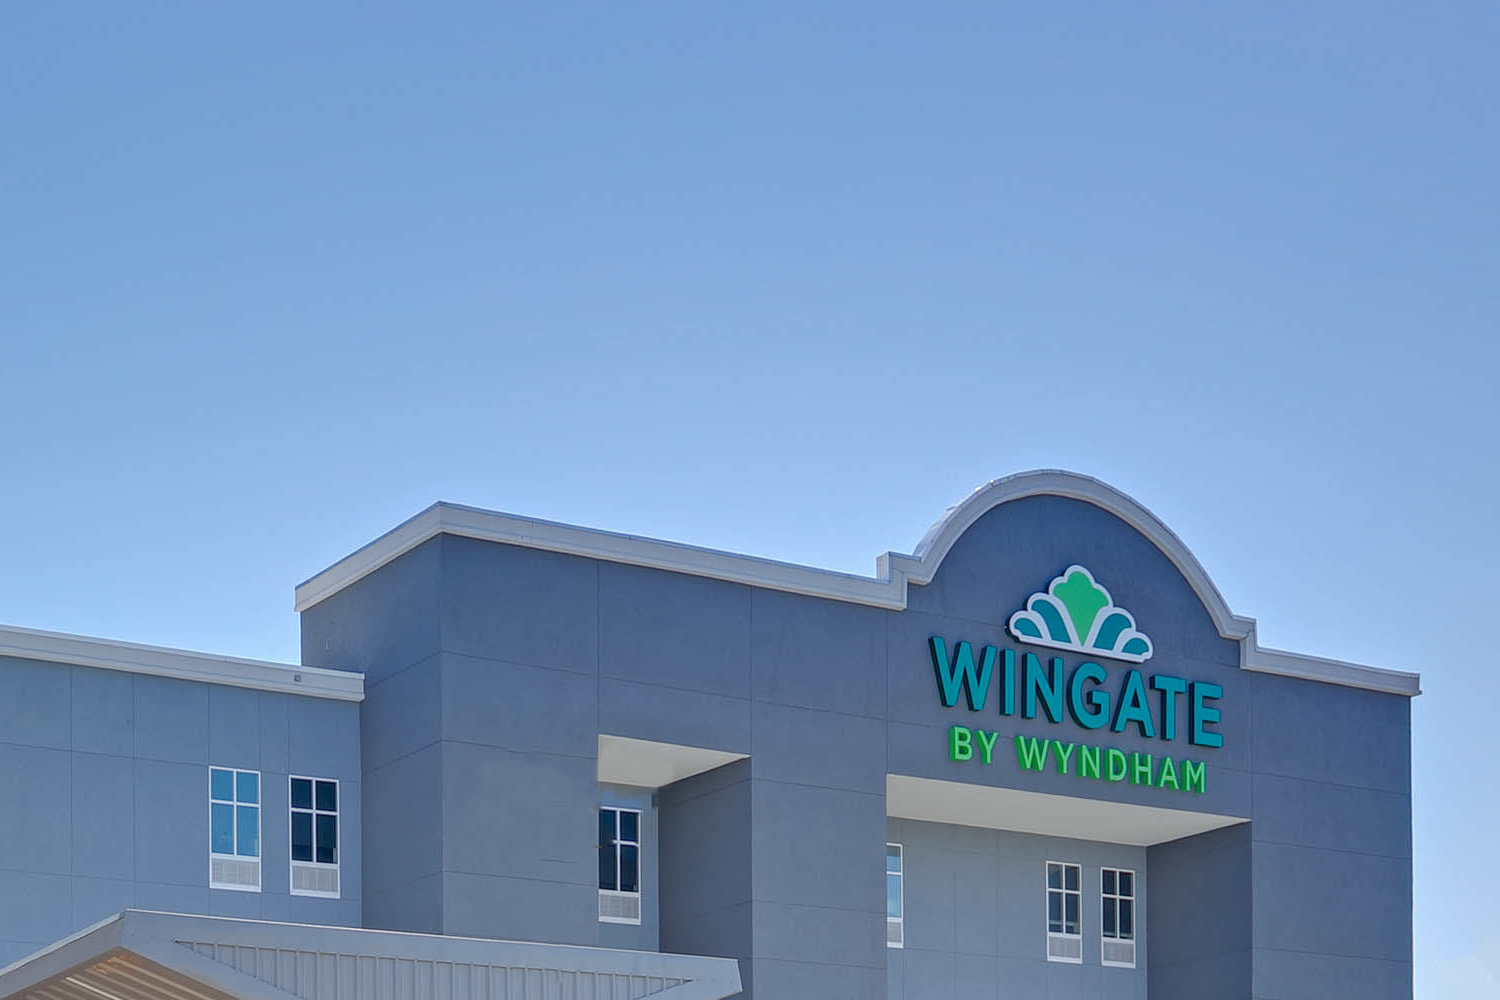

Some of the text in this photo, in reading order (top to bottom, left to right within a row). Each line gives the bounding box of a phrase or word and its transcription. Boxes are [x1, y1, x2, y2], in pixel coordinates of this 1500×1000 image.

[928, 635, 1224, 748] WINGATE
[950, 725, 1206, 793] BY WYNDHAM
